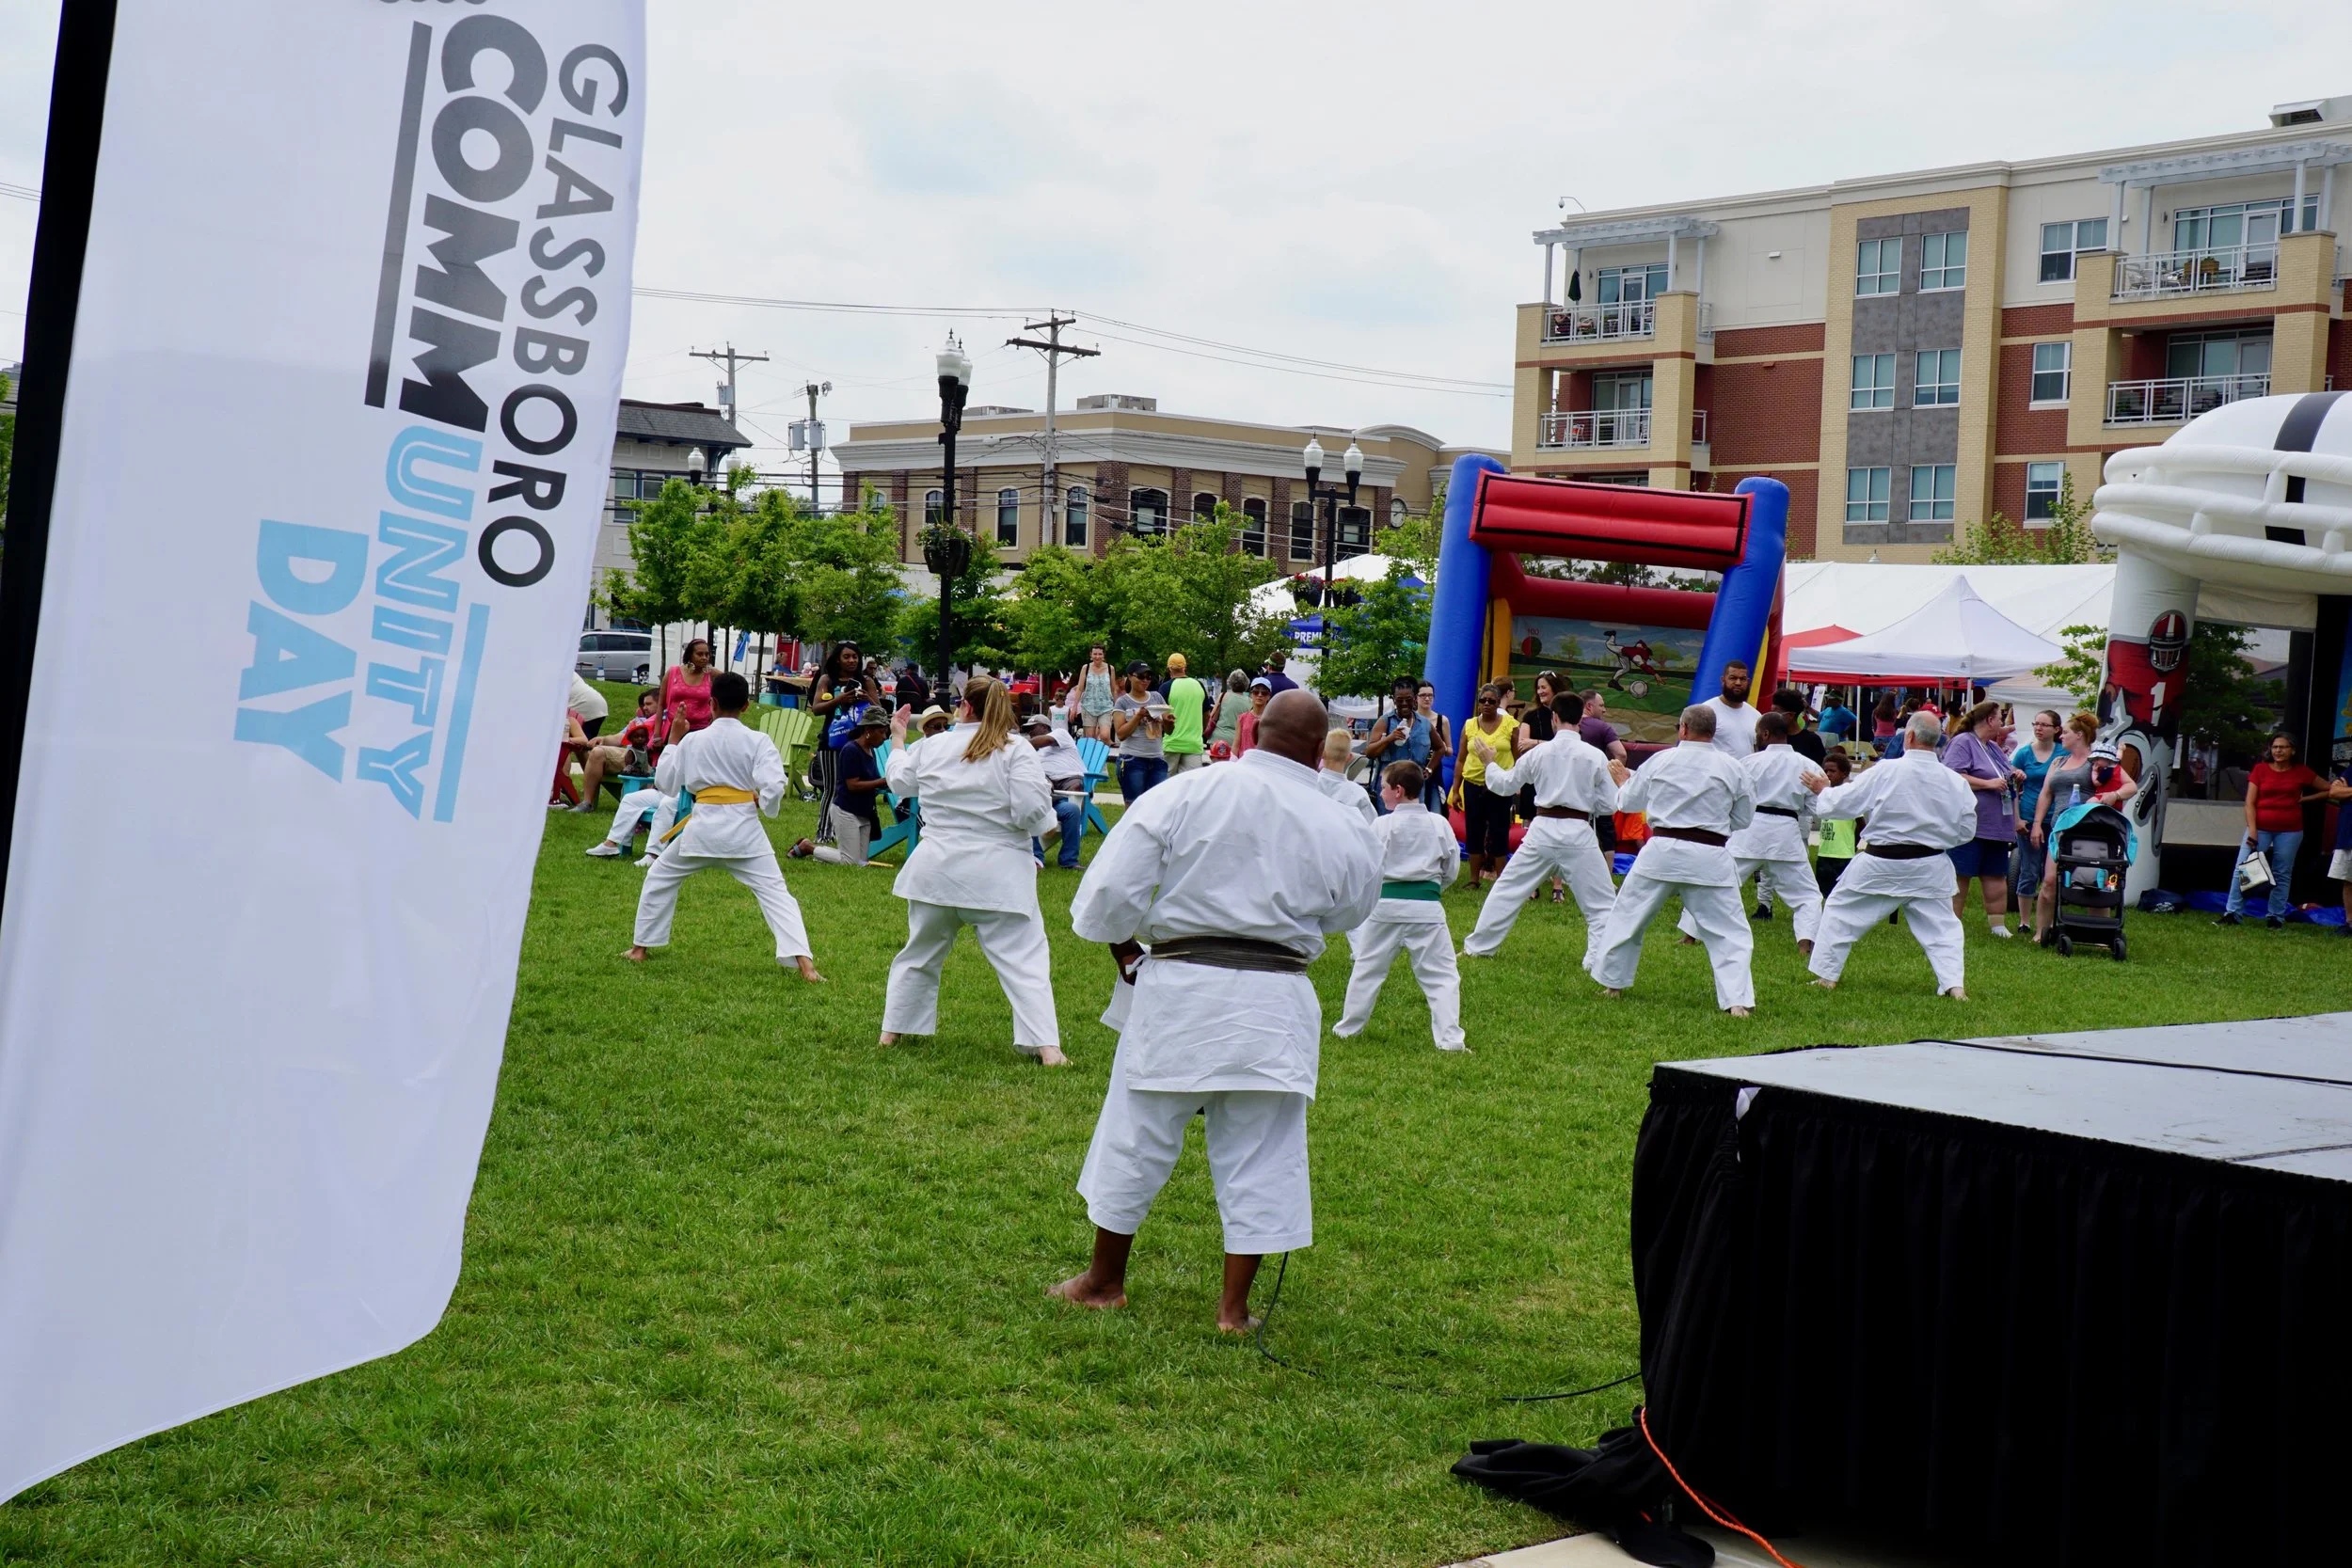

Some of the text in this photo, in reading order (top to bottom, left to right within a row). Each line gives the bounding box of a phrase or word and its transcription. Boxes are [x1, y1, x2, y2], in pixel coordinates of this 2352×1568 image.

[356, 14, 548, 820] COMMUNITY
[478, 44, 629, 588] GLASSBORO
[233, 519, 369, 783] DAY
